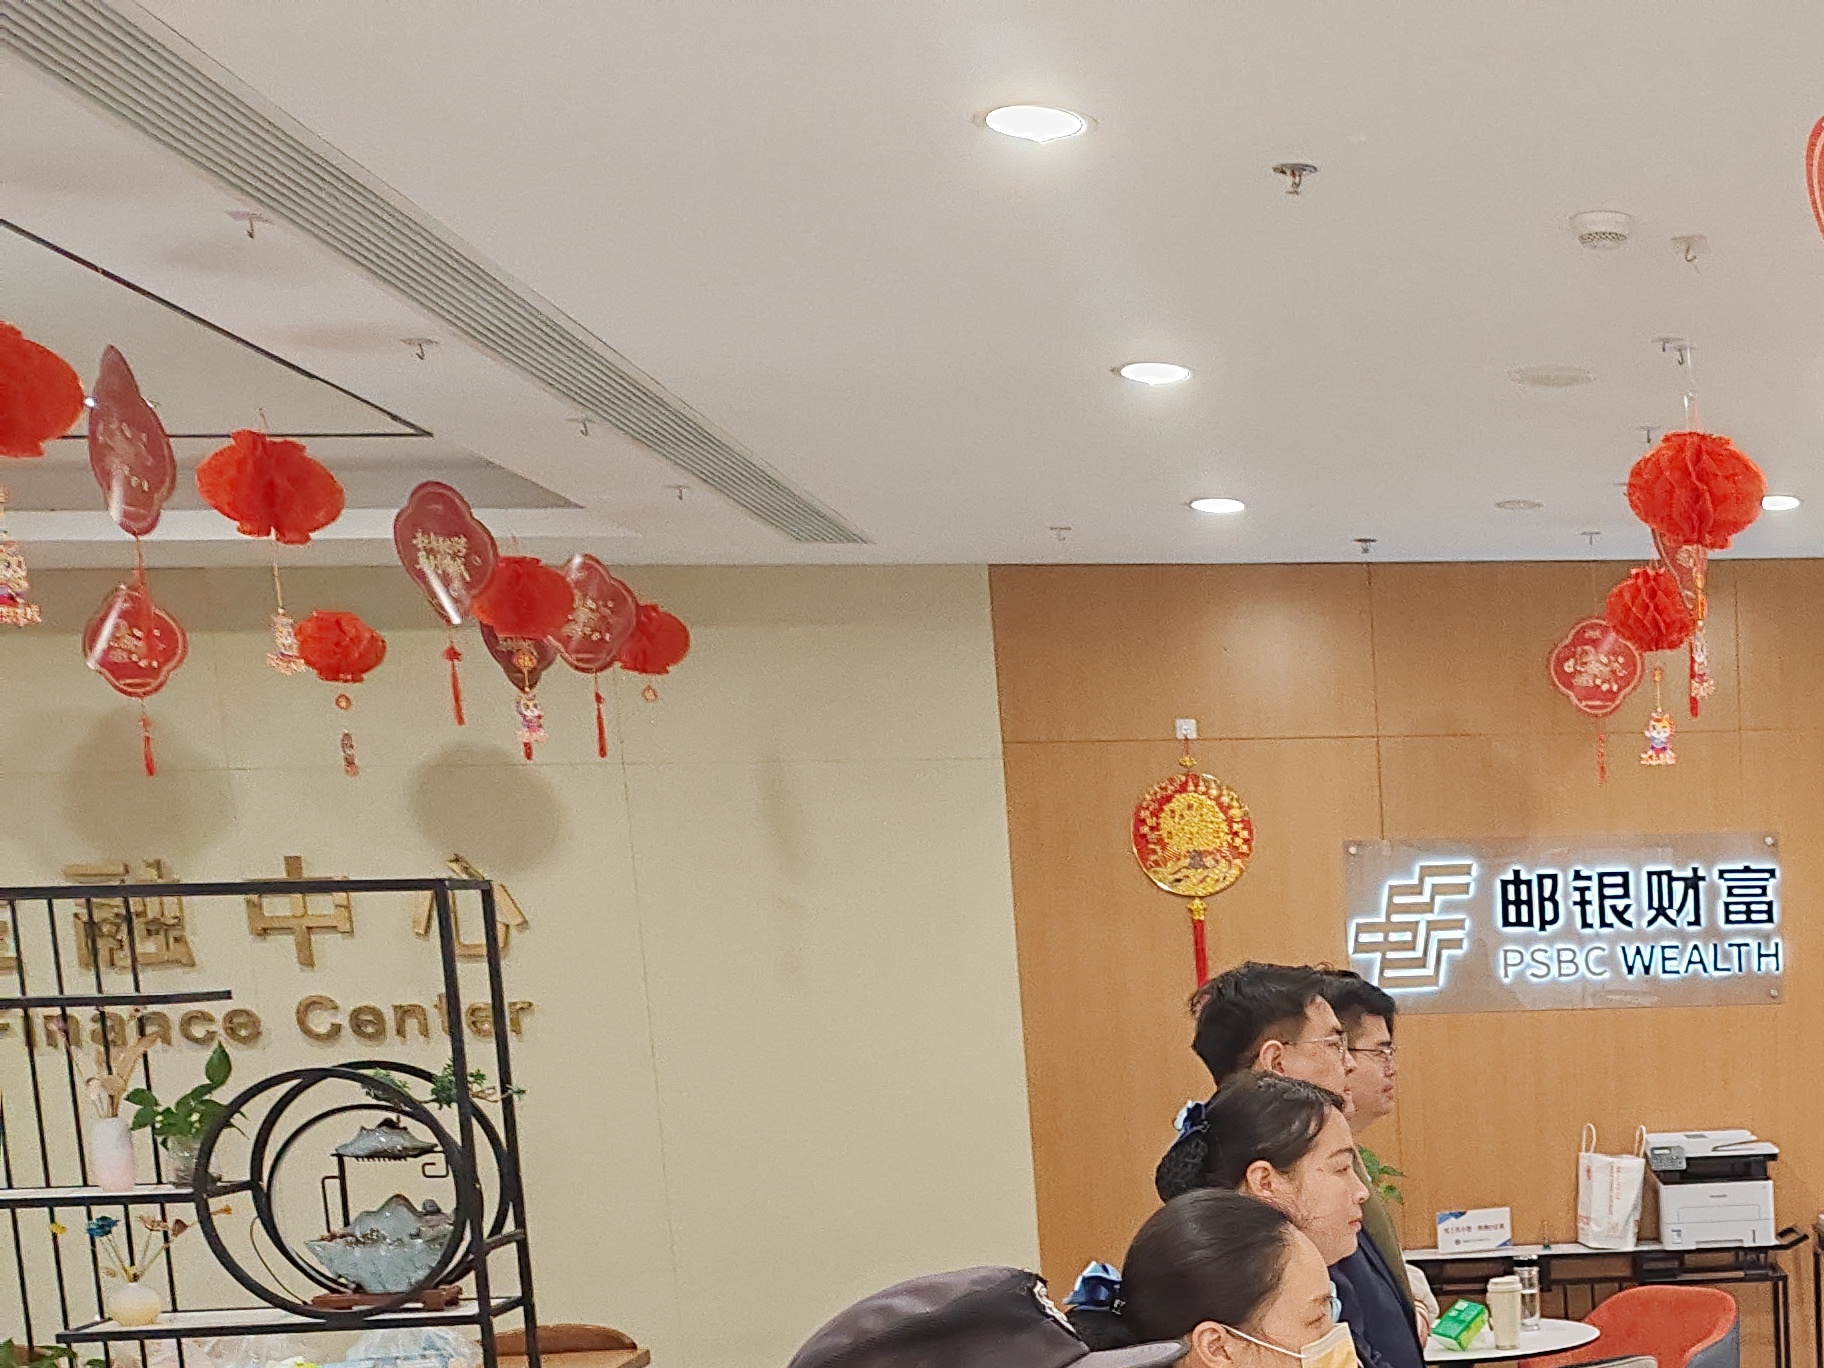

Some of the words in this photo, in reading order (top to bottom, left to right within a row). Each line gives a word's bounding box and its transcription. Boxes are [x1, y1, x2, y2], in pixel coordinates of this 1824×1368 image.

[0, 854, 529, 968] 融中心
[1499, 865, 1777, 932] 邮银财富
[1502, 946, 1609, 980] PSBC
[1620, 941, 1780, 976] WEALTH
